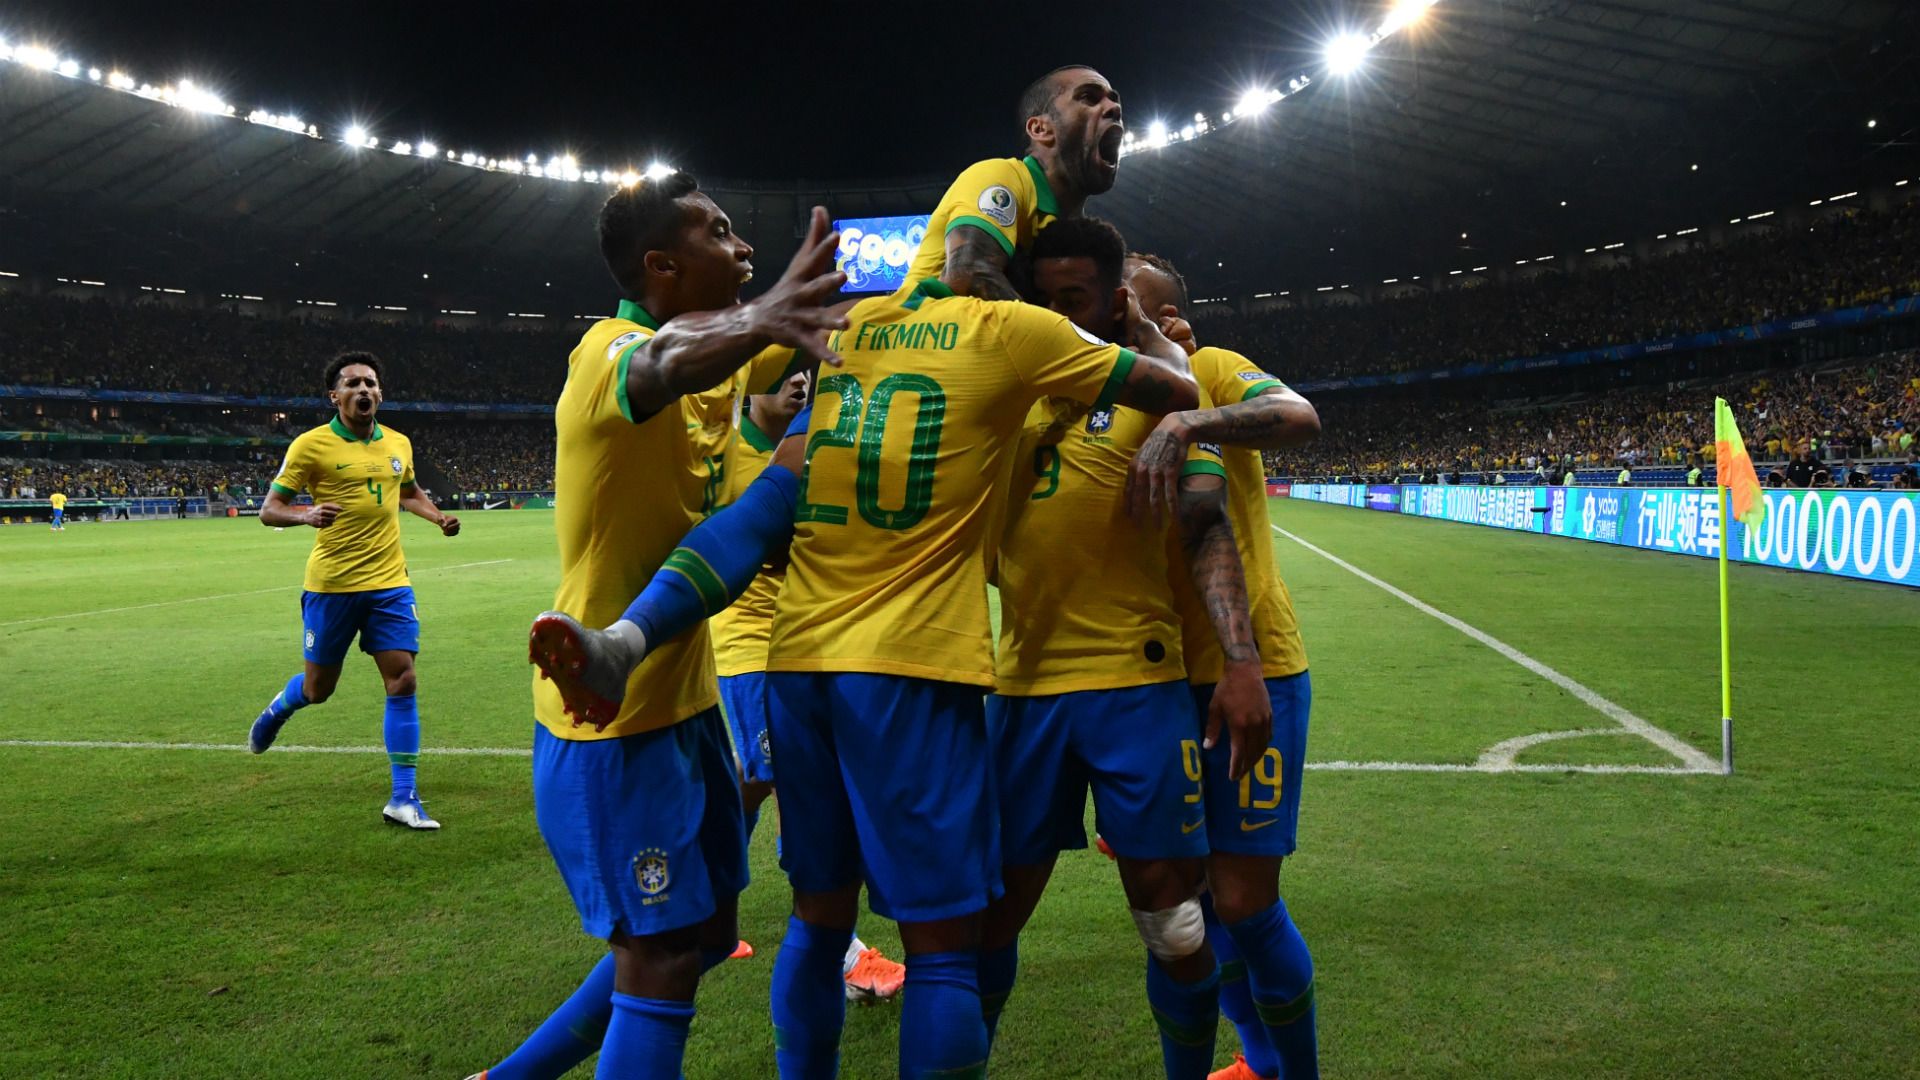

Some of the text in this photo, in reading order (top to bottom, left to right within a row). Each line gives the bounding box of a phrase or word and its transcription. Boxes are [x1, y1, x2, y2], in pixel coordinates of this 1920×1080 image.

[855, 321, 959, 350] FIRMINO
[793, 373, 947, 530] 20
[1032, 444, 1061, 500] 9
[367, 477, 383, 505] 4
[1598, 491, 1618, 516] yabo
[1638, 491, 1720, 555] 行业领军
[1180, 739, 1202, 803] 9
[1238, 747, 1283, 809] 19
